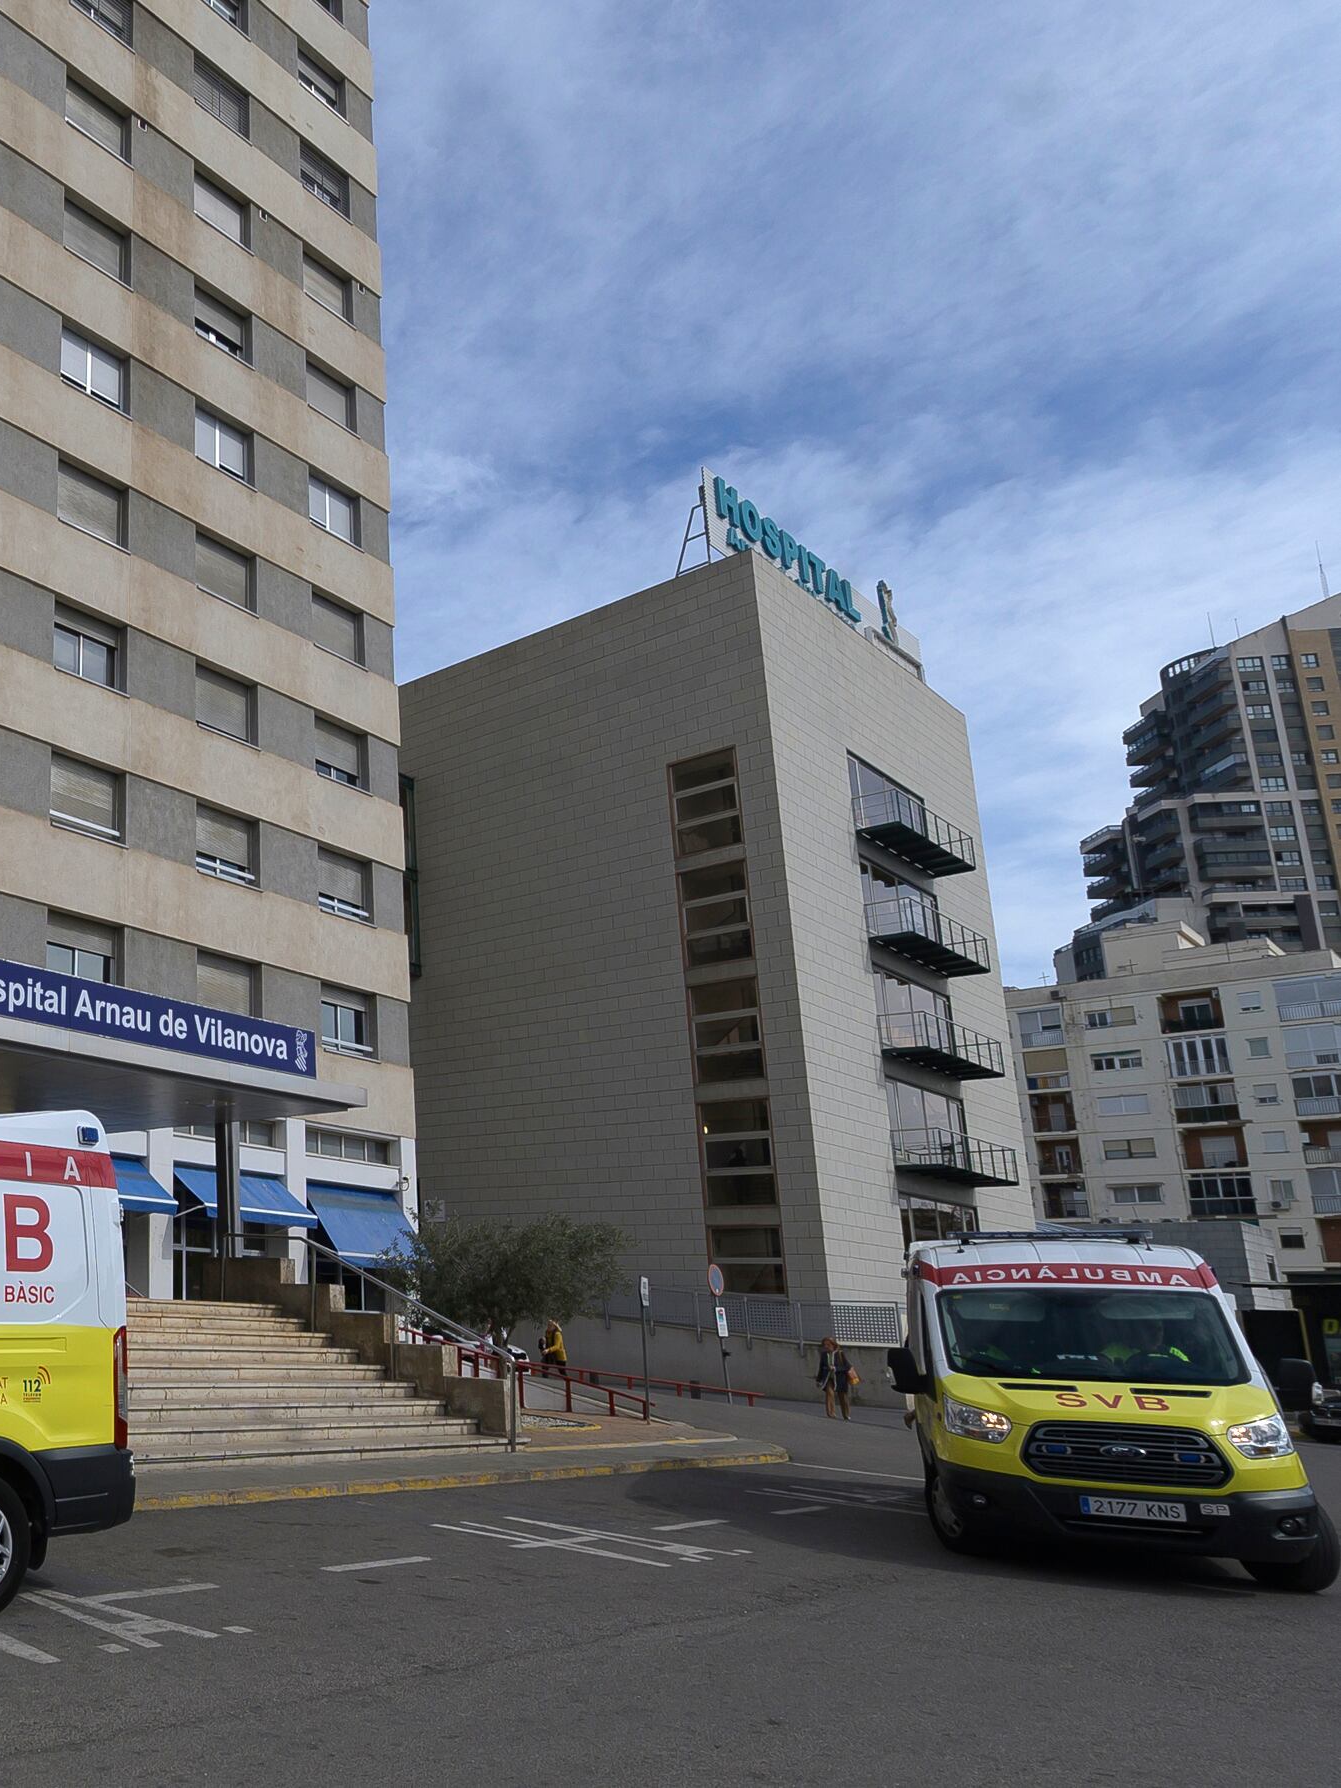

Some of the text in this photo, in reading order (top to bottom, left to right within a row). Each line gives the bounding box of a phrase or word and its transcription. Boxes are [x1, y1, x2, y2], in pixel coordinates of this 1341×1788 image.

[714, 476, 861, 623] HOSPITAL
[74, 989, 151, 1032] Arnau
[159, 1009, 188, 1039] de
[194, 1013, 288, 1060] Vilanova
[4, 1280, 55, 1304] BÀSIC
[22, 1379, 41, 1393] 112
[1054, 1392, 1171, 1412] SVB
[1093, 1499, 1181, 1520] 2177 KNS
[1202, 1504, 1228, 1515] SP
